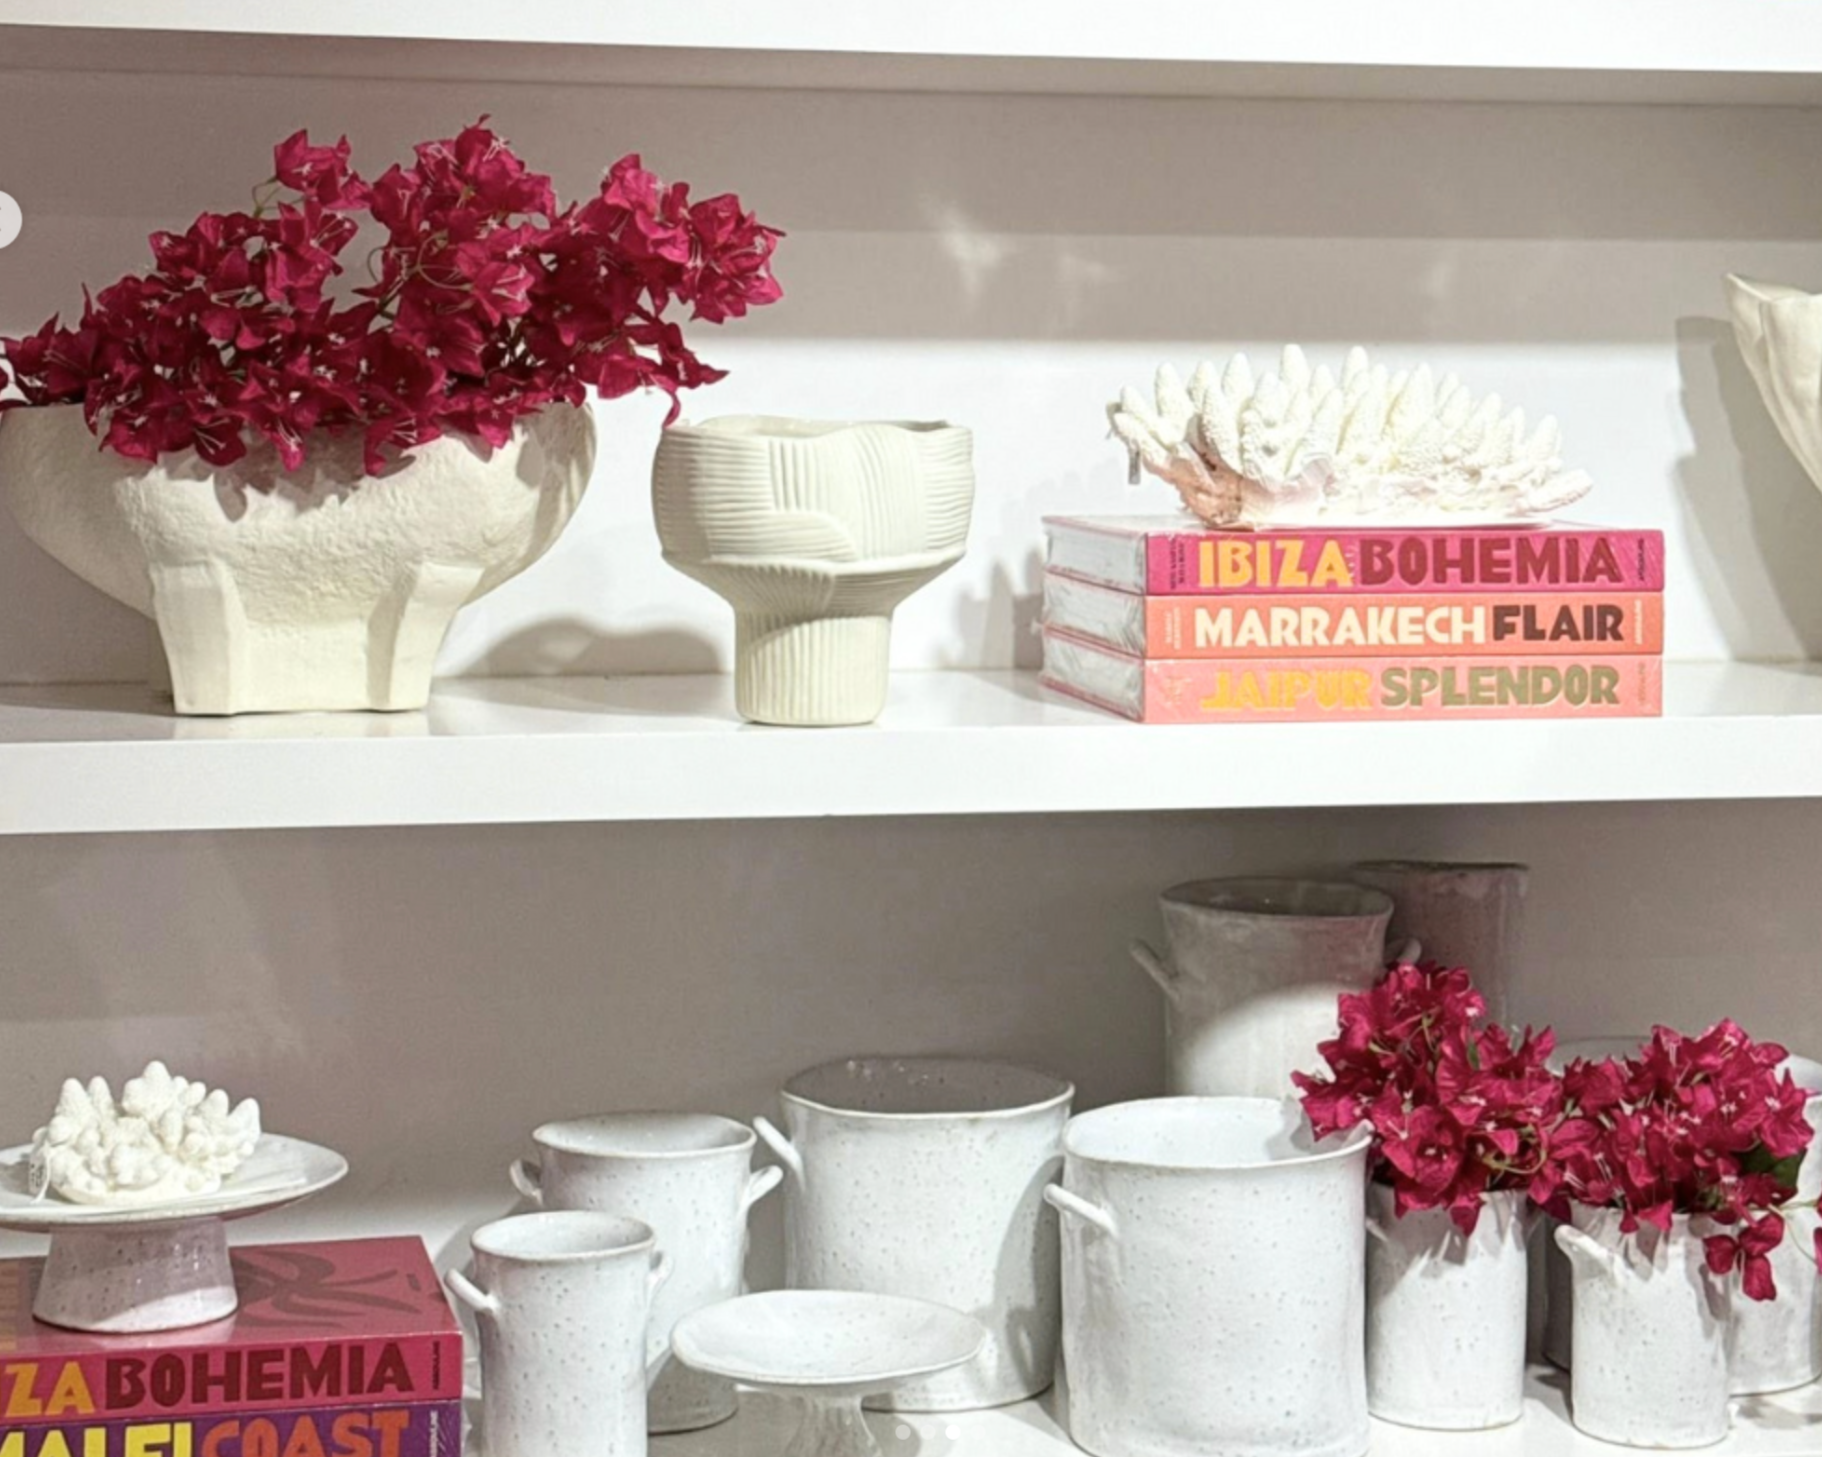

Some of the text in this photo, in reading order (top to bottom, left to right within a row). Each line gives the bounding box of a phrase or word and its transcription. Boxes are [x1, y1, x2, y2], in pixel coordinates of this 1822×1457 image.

[1199, 539, 1354, 588] IBIZA
[1359, 536, 1624, 586] BOHEMIA
[1195, 605, 1486, 647] MARRAKECH
[1492, 604, 1624, 642] FLAIR
[1201, 667, 1373, 711] JAIPUR
[1380, 664, 1620, 708] SPLENDOR
[105, 1342, 415, 1410] BOHEMIA
[0, 1421, 193, 1457] ALFI
[201, 1409, 409, 1457] COAST
